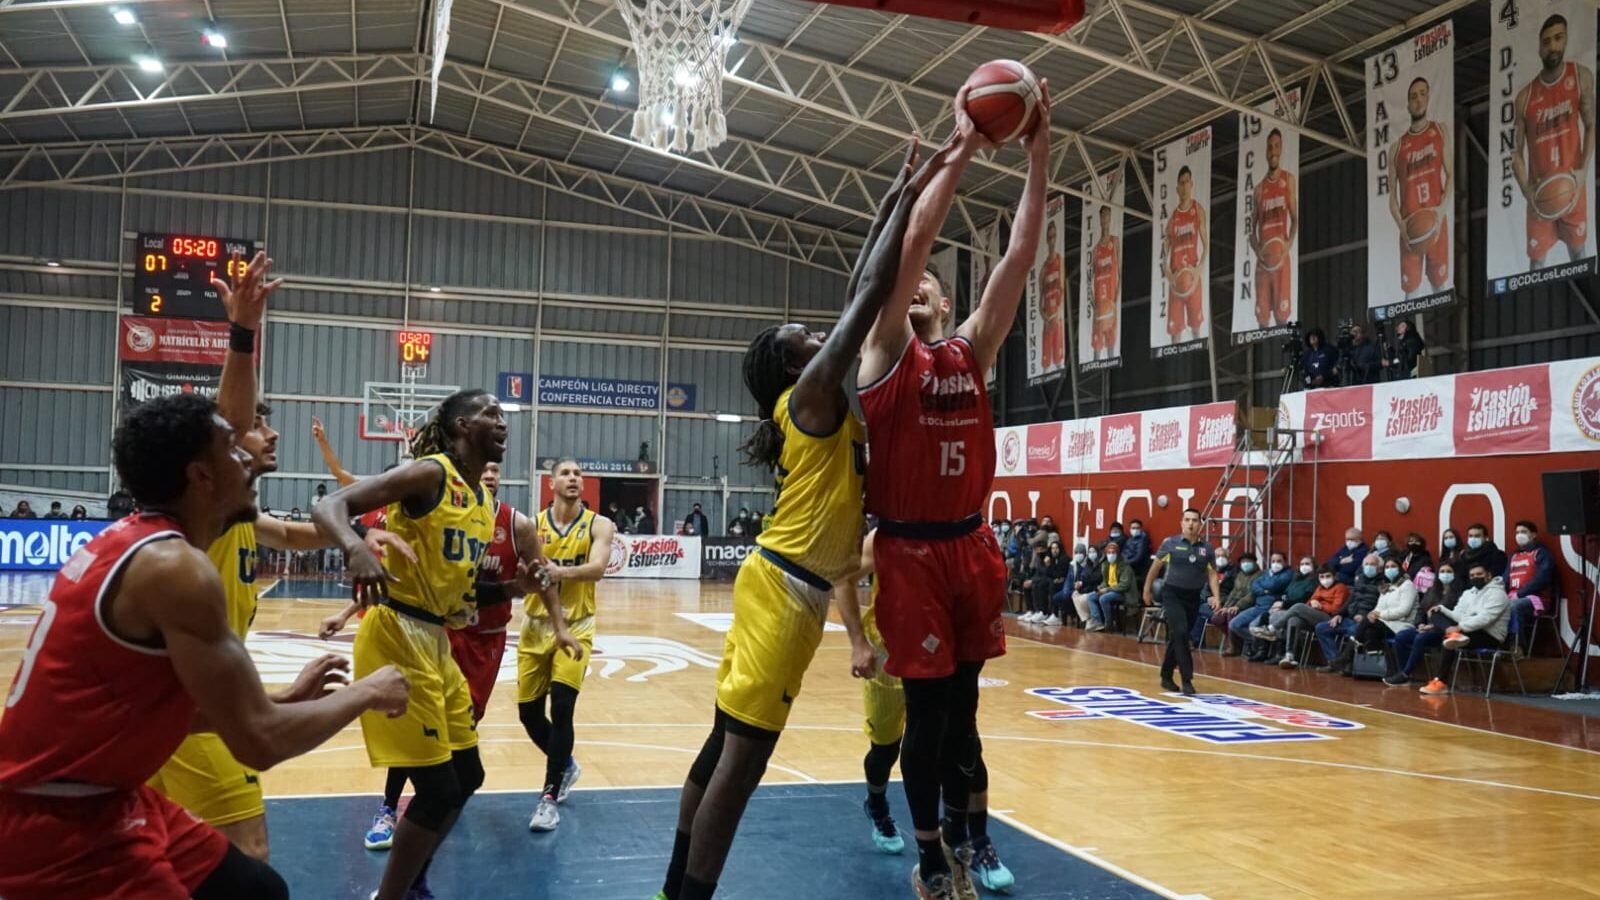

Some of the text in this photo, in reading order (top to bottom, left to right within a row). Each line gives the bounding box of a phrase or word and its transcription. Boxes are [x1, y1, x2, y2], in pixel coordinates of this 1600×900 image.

[1373, 48, 1399, 88] 13
[1374, 101, 1390, 196] AMOR
[1157, 149, 1167, 173] 5
[144, 237, 164, 249] Local
[173, 238, 216, 257] 05:20
[145, 254, 166, 271] 07
[1508, 262, 1589, 291] @CDCLosLeones
[150, 295, 161, 312] 2
[160, 334, 210, 348] MATRÍCULAS
[399, 332, 431, 345] 05:20
[404, 343, 428, 361] 04
[538, 378, 659, 396] CAMPEÓN LIGA DIRECTV
[540, 391, 656, 408] CONFERENCIA CENTRO
[1398, 393, 1439, 418] Pasión
[1481, 383, 1531, 412] Pasión
[1385, 411, 1438, 438] Esfuerzo
[1466, 404, 1531, 433] Esfuerzo
[940, 441, 966, 476] 15
[0, 524, 93, 566] molte
[639, 538, 679, 555] Pasión
[628, 552, 678, 568] Esfuerzo
